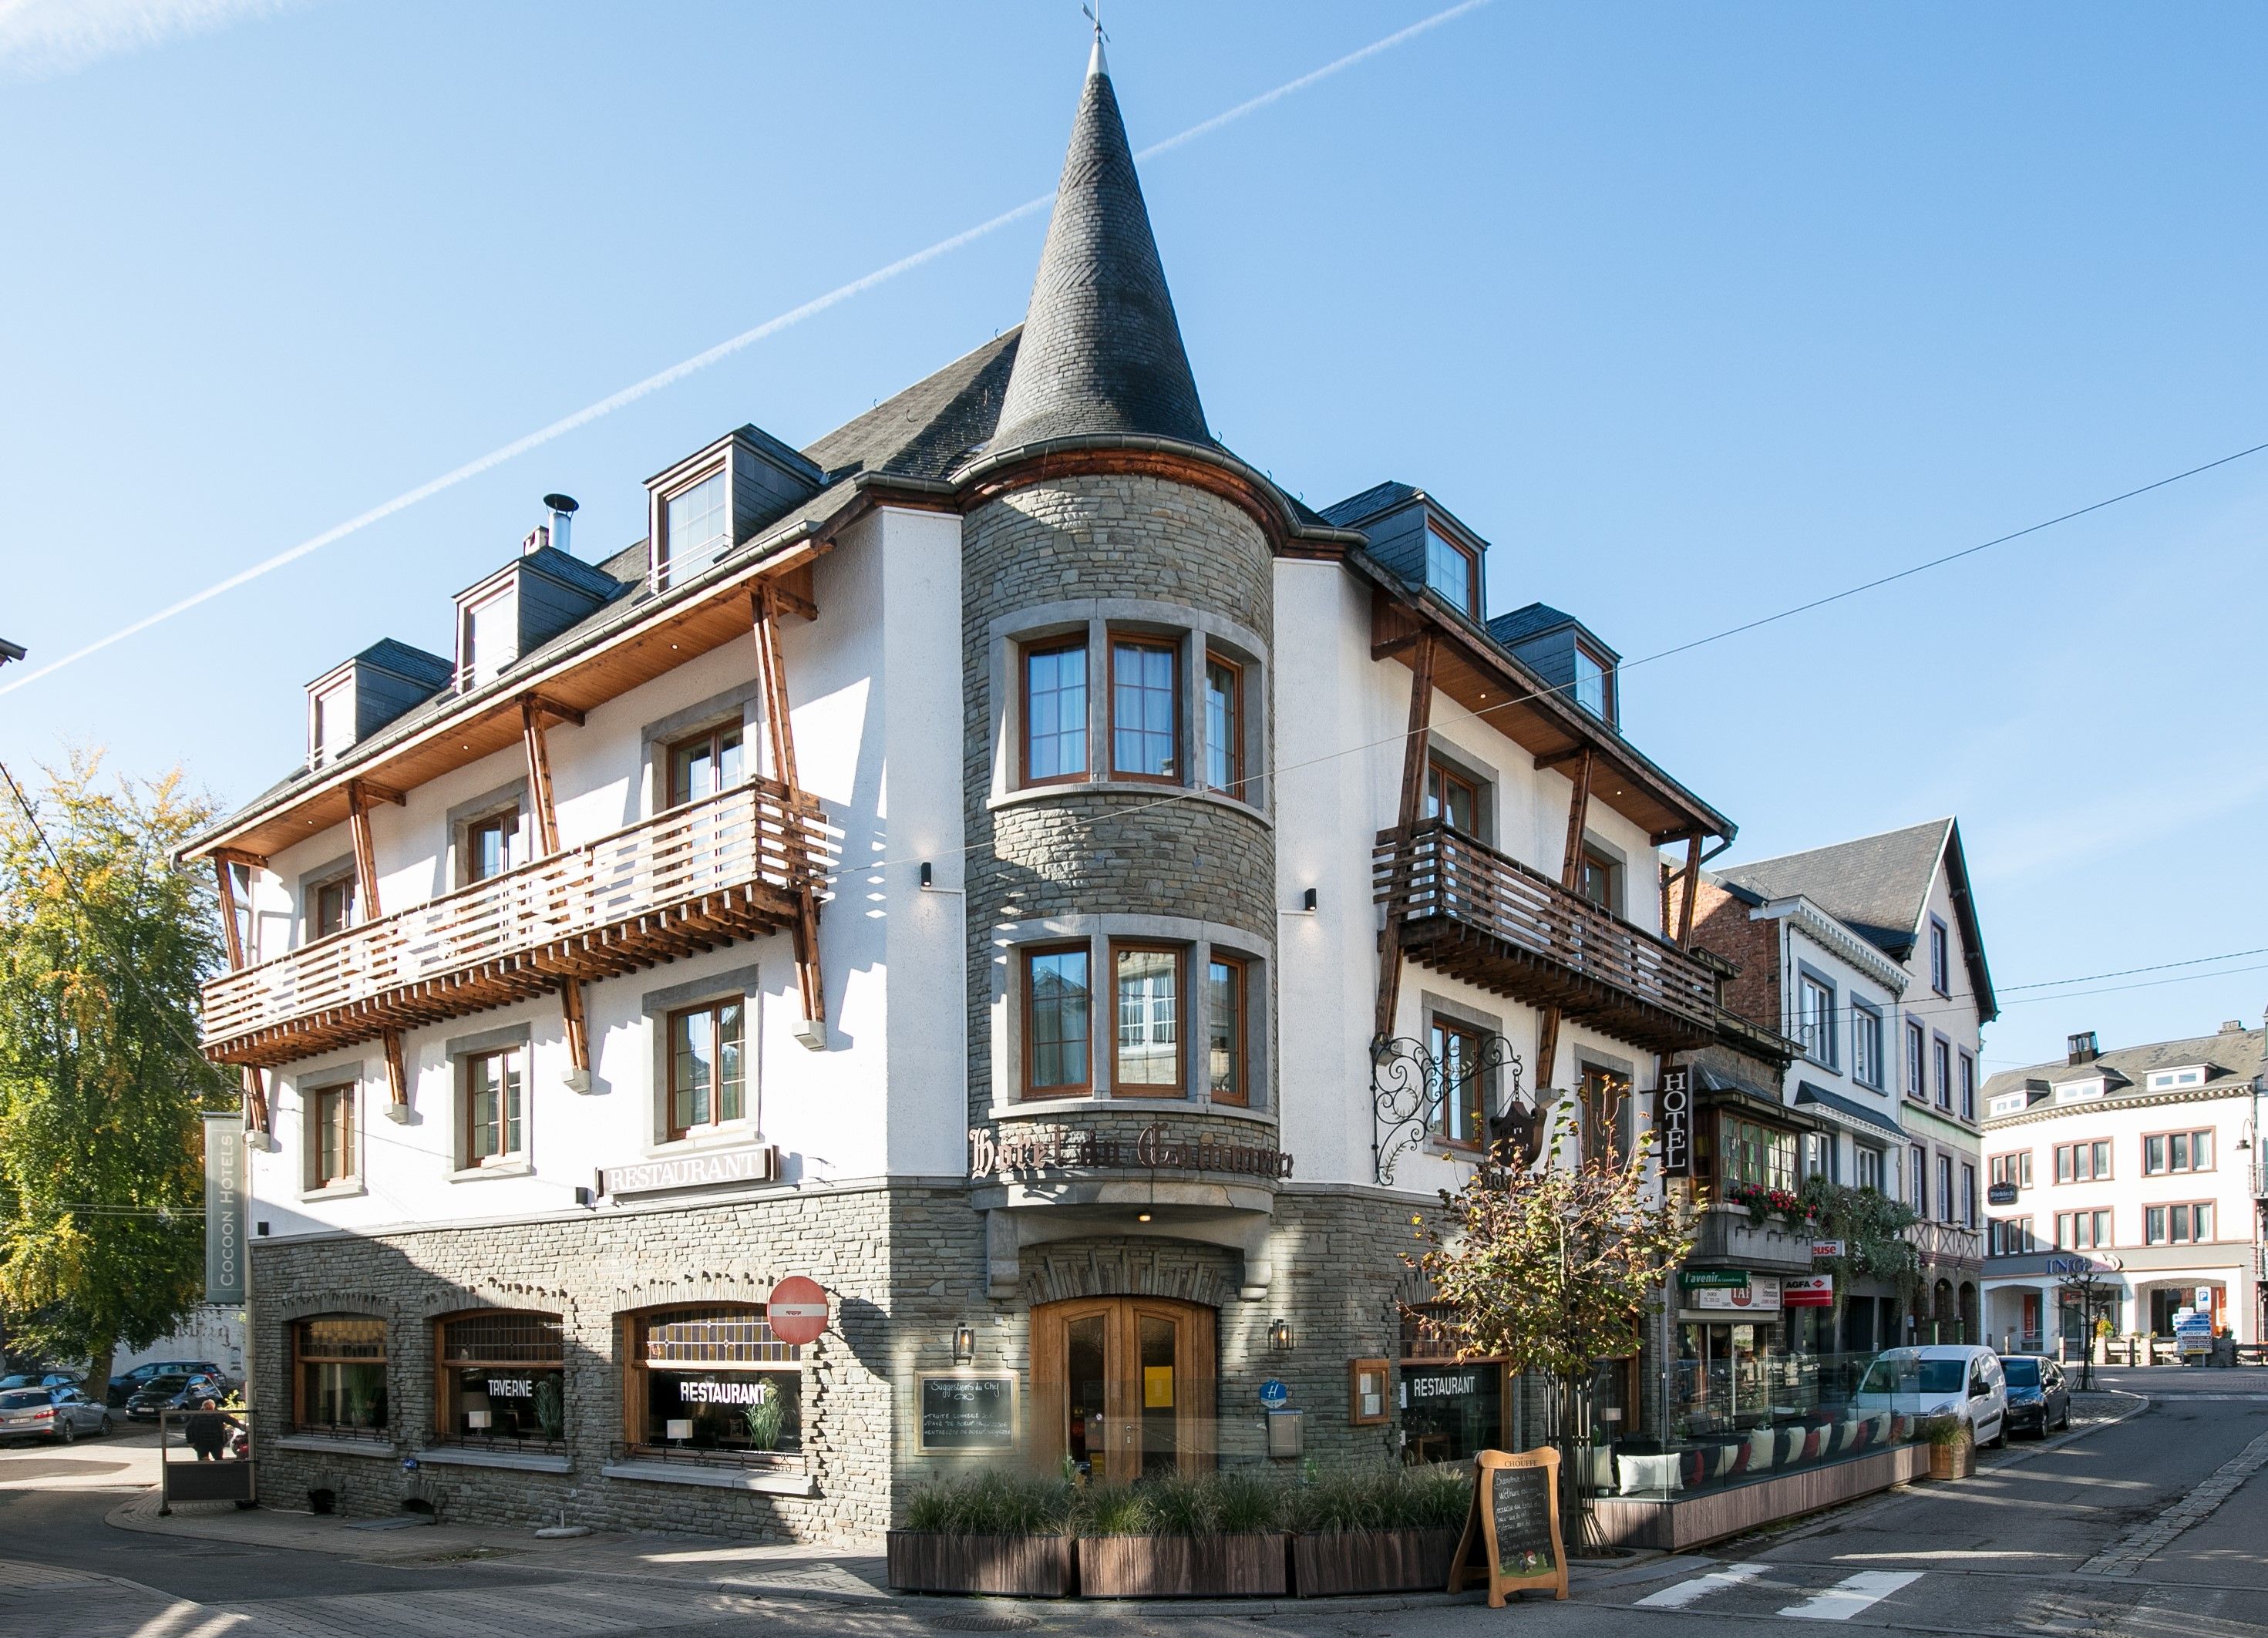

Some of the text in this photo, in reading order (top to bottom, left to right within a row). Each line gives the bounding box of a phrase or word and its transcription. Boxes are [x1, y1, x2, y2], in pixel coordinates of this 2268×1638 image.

[1664, 1072, 1686, 1168] HOTEL
[1080, 1128, 1120, 1168] du
[608, 1151, 759, 1192] RESTAURANT
[220, 1135, 234, 1287] COCOON HOTELS
[2048, 1257, 2088, 1273] ING
[1785, 1280, 1811, 1289] AGFA
[488, 1380, 533, 1398] TAVERNE
[680, 1381, 766, 1404] RESTAURANT
[931, 1381, 1000, 1398] Suggestions du Chef
[1414, 1376, 1476, 1397] RESTAURANT
